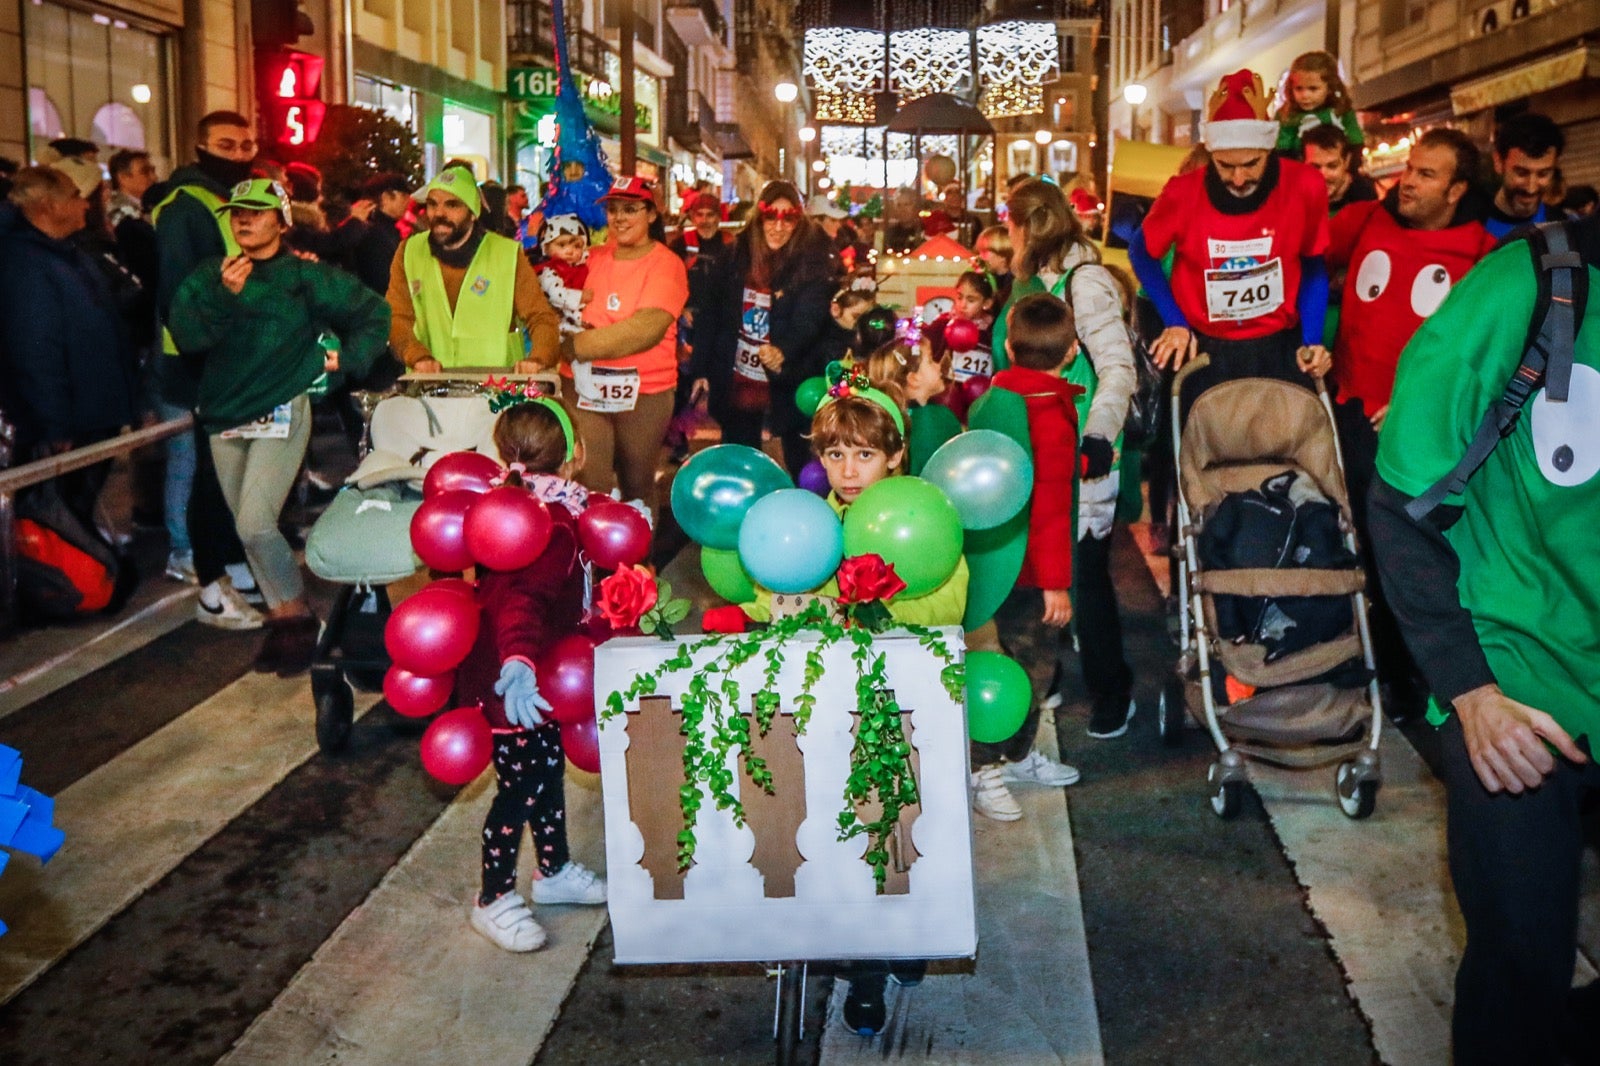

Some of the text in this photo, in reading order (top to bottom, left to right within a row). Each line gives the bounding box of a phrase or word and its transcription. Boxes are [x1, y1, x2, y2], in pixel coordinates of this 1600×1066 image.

[286, 106, 304, 145] 5
[1222, 284, 1270, 307] 740
[962, 356, 989, 374] 212
[600, 385, 633, 399] 152
